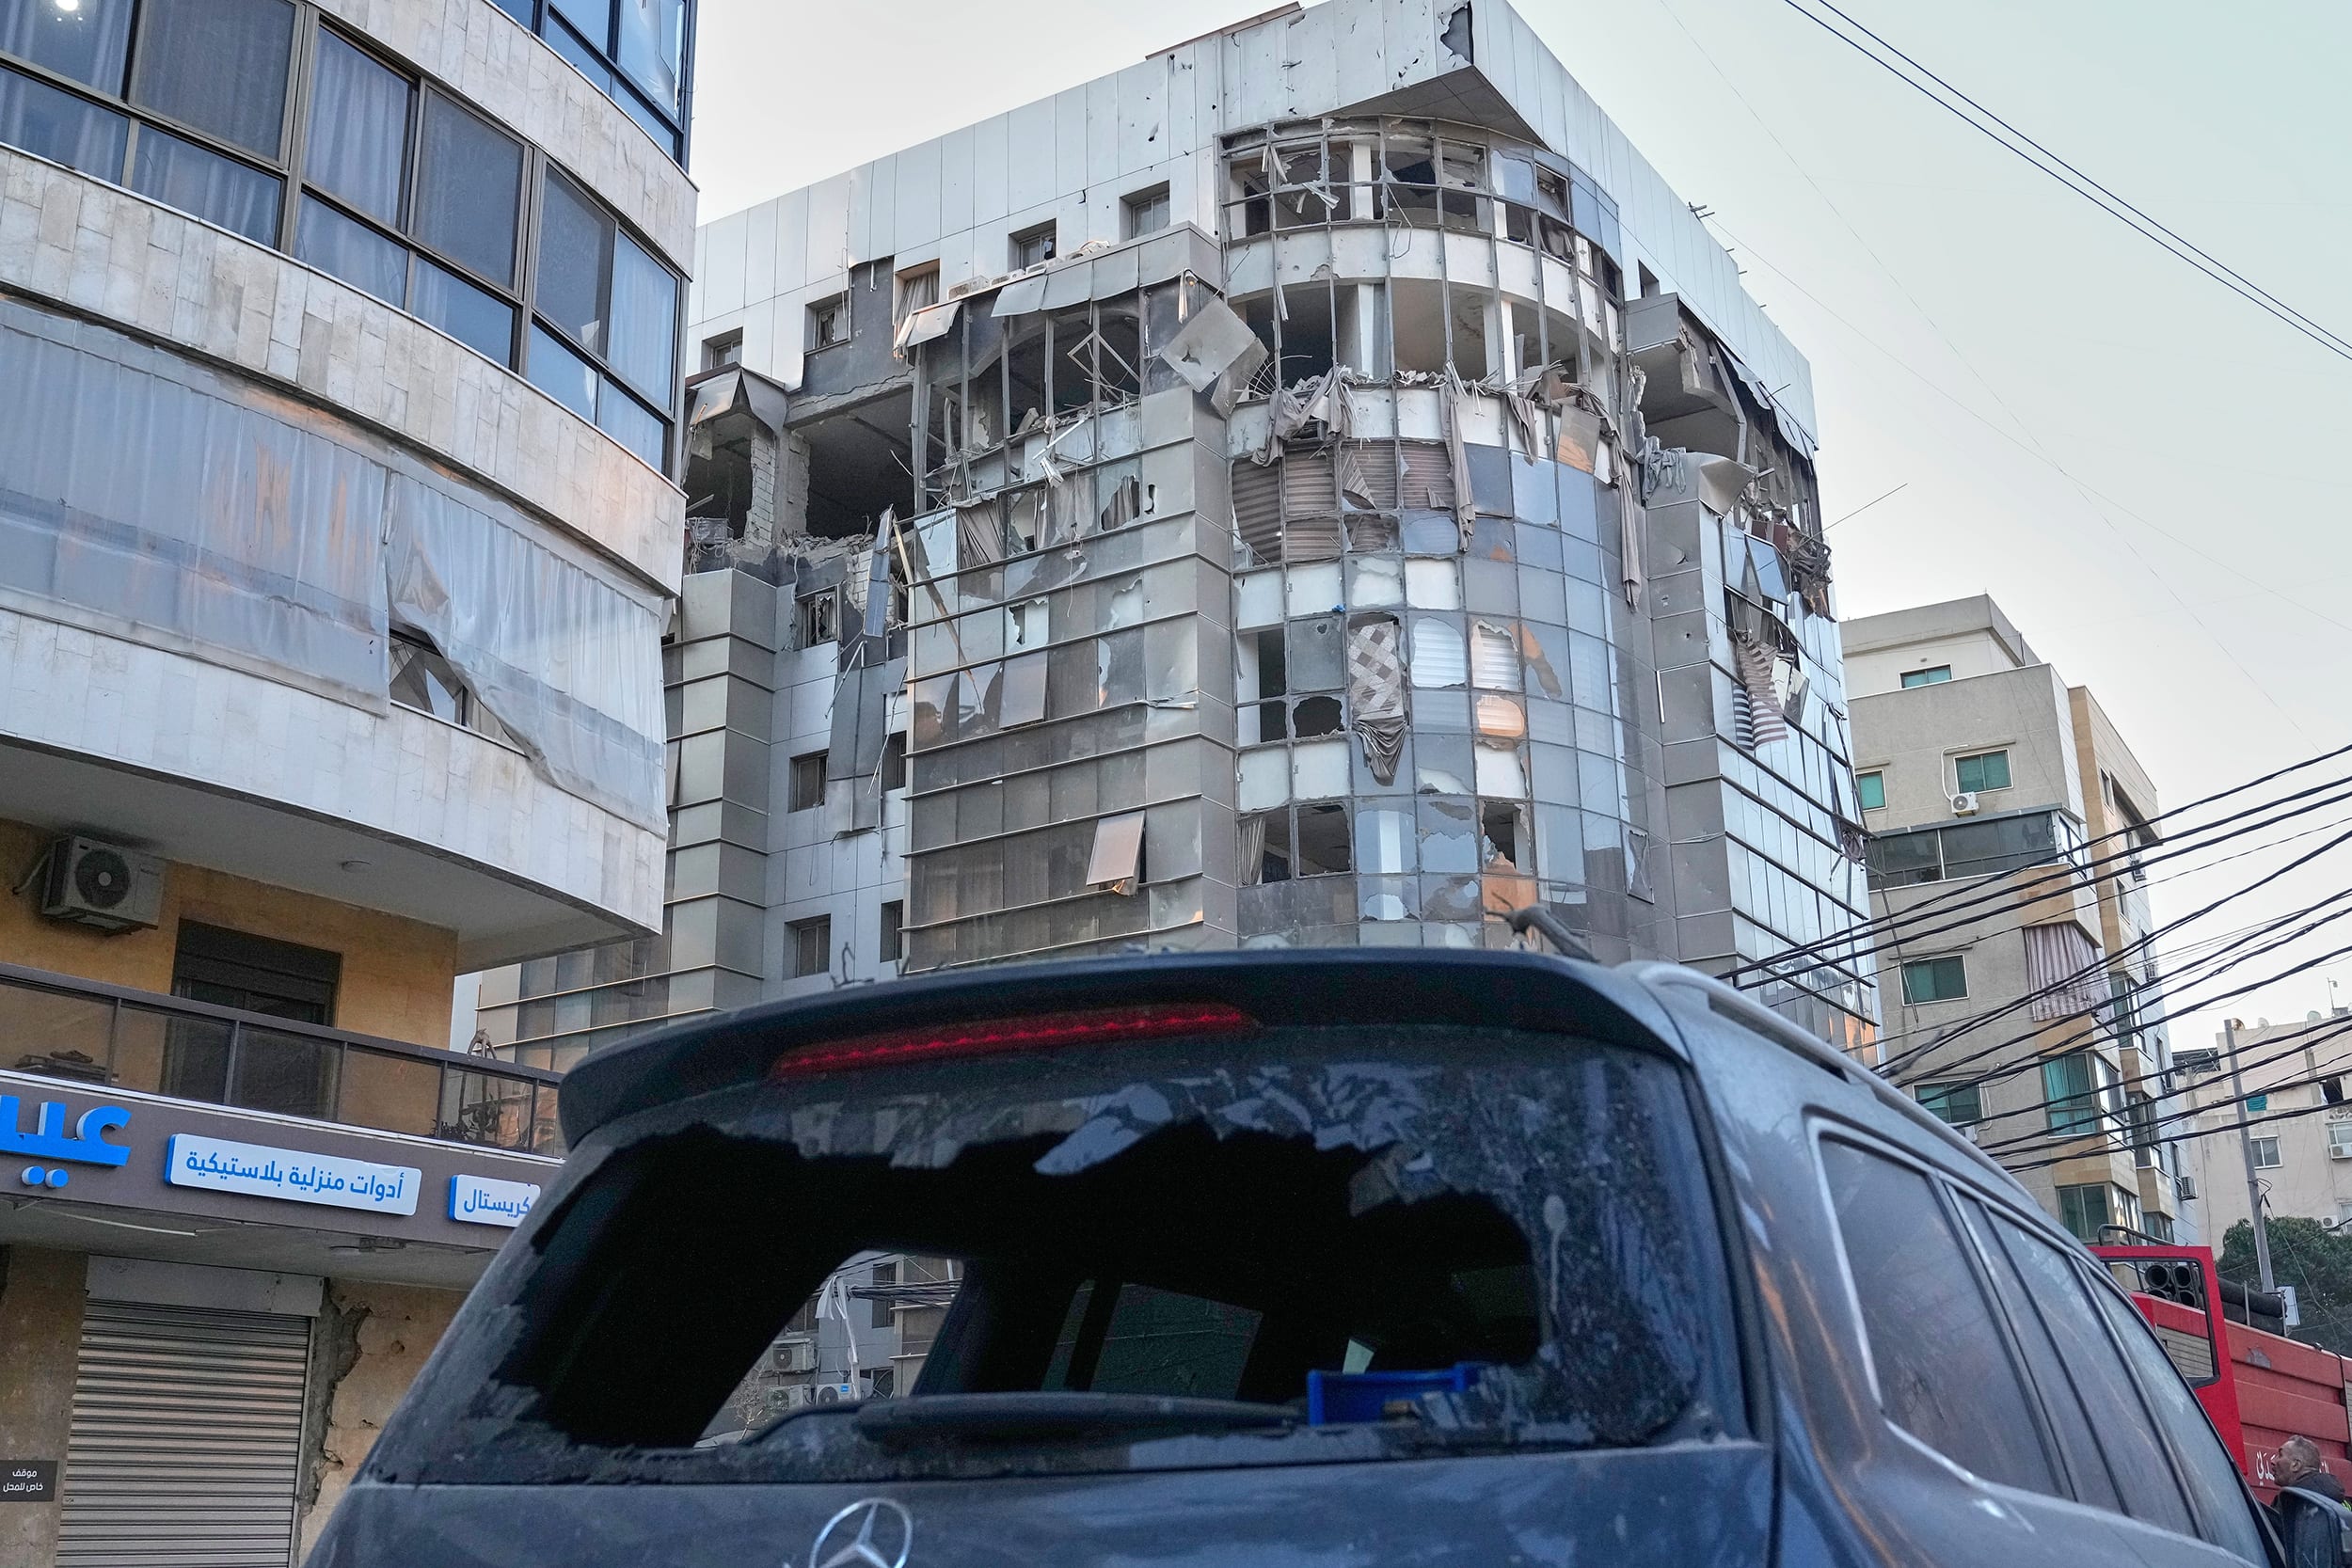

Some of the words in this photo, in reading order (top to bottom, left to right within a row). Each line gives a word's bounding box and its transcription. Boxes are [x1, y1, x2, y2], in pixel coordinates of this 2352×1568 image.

[186, 1150, 283, 1187] بلاستيكية
[288, 1165, 344, 1194] منزلية
[350, 1172, 405, 1202] أدوات
[463, 1188, 531, 1218] كريستال
[3, 1481, 25, 1493] للمحل
[12, 1468, 38, 1479] موقف
[25, 1482, 43, 1493] خاص
